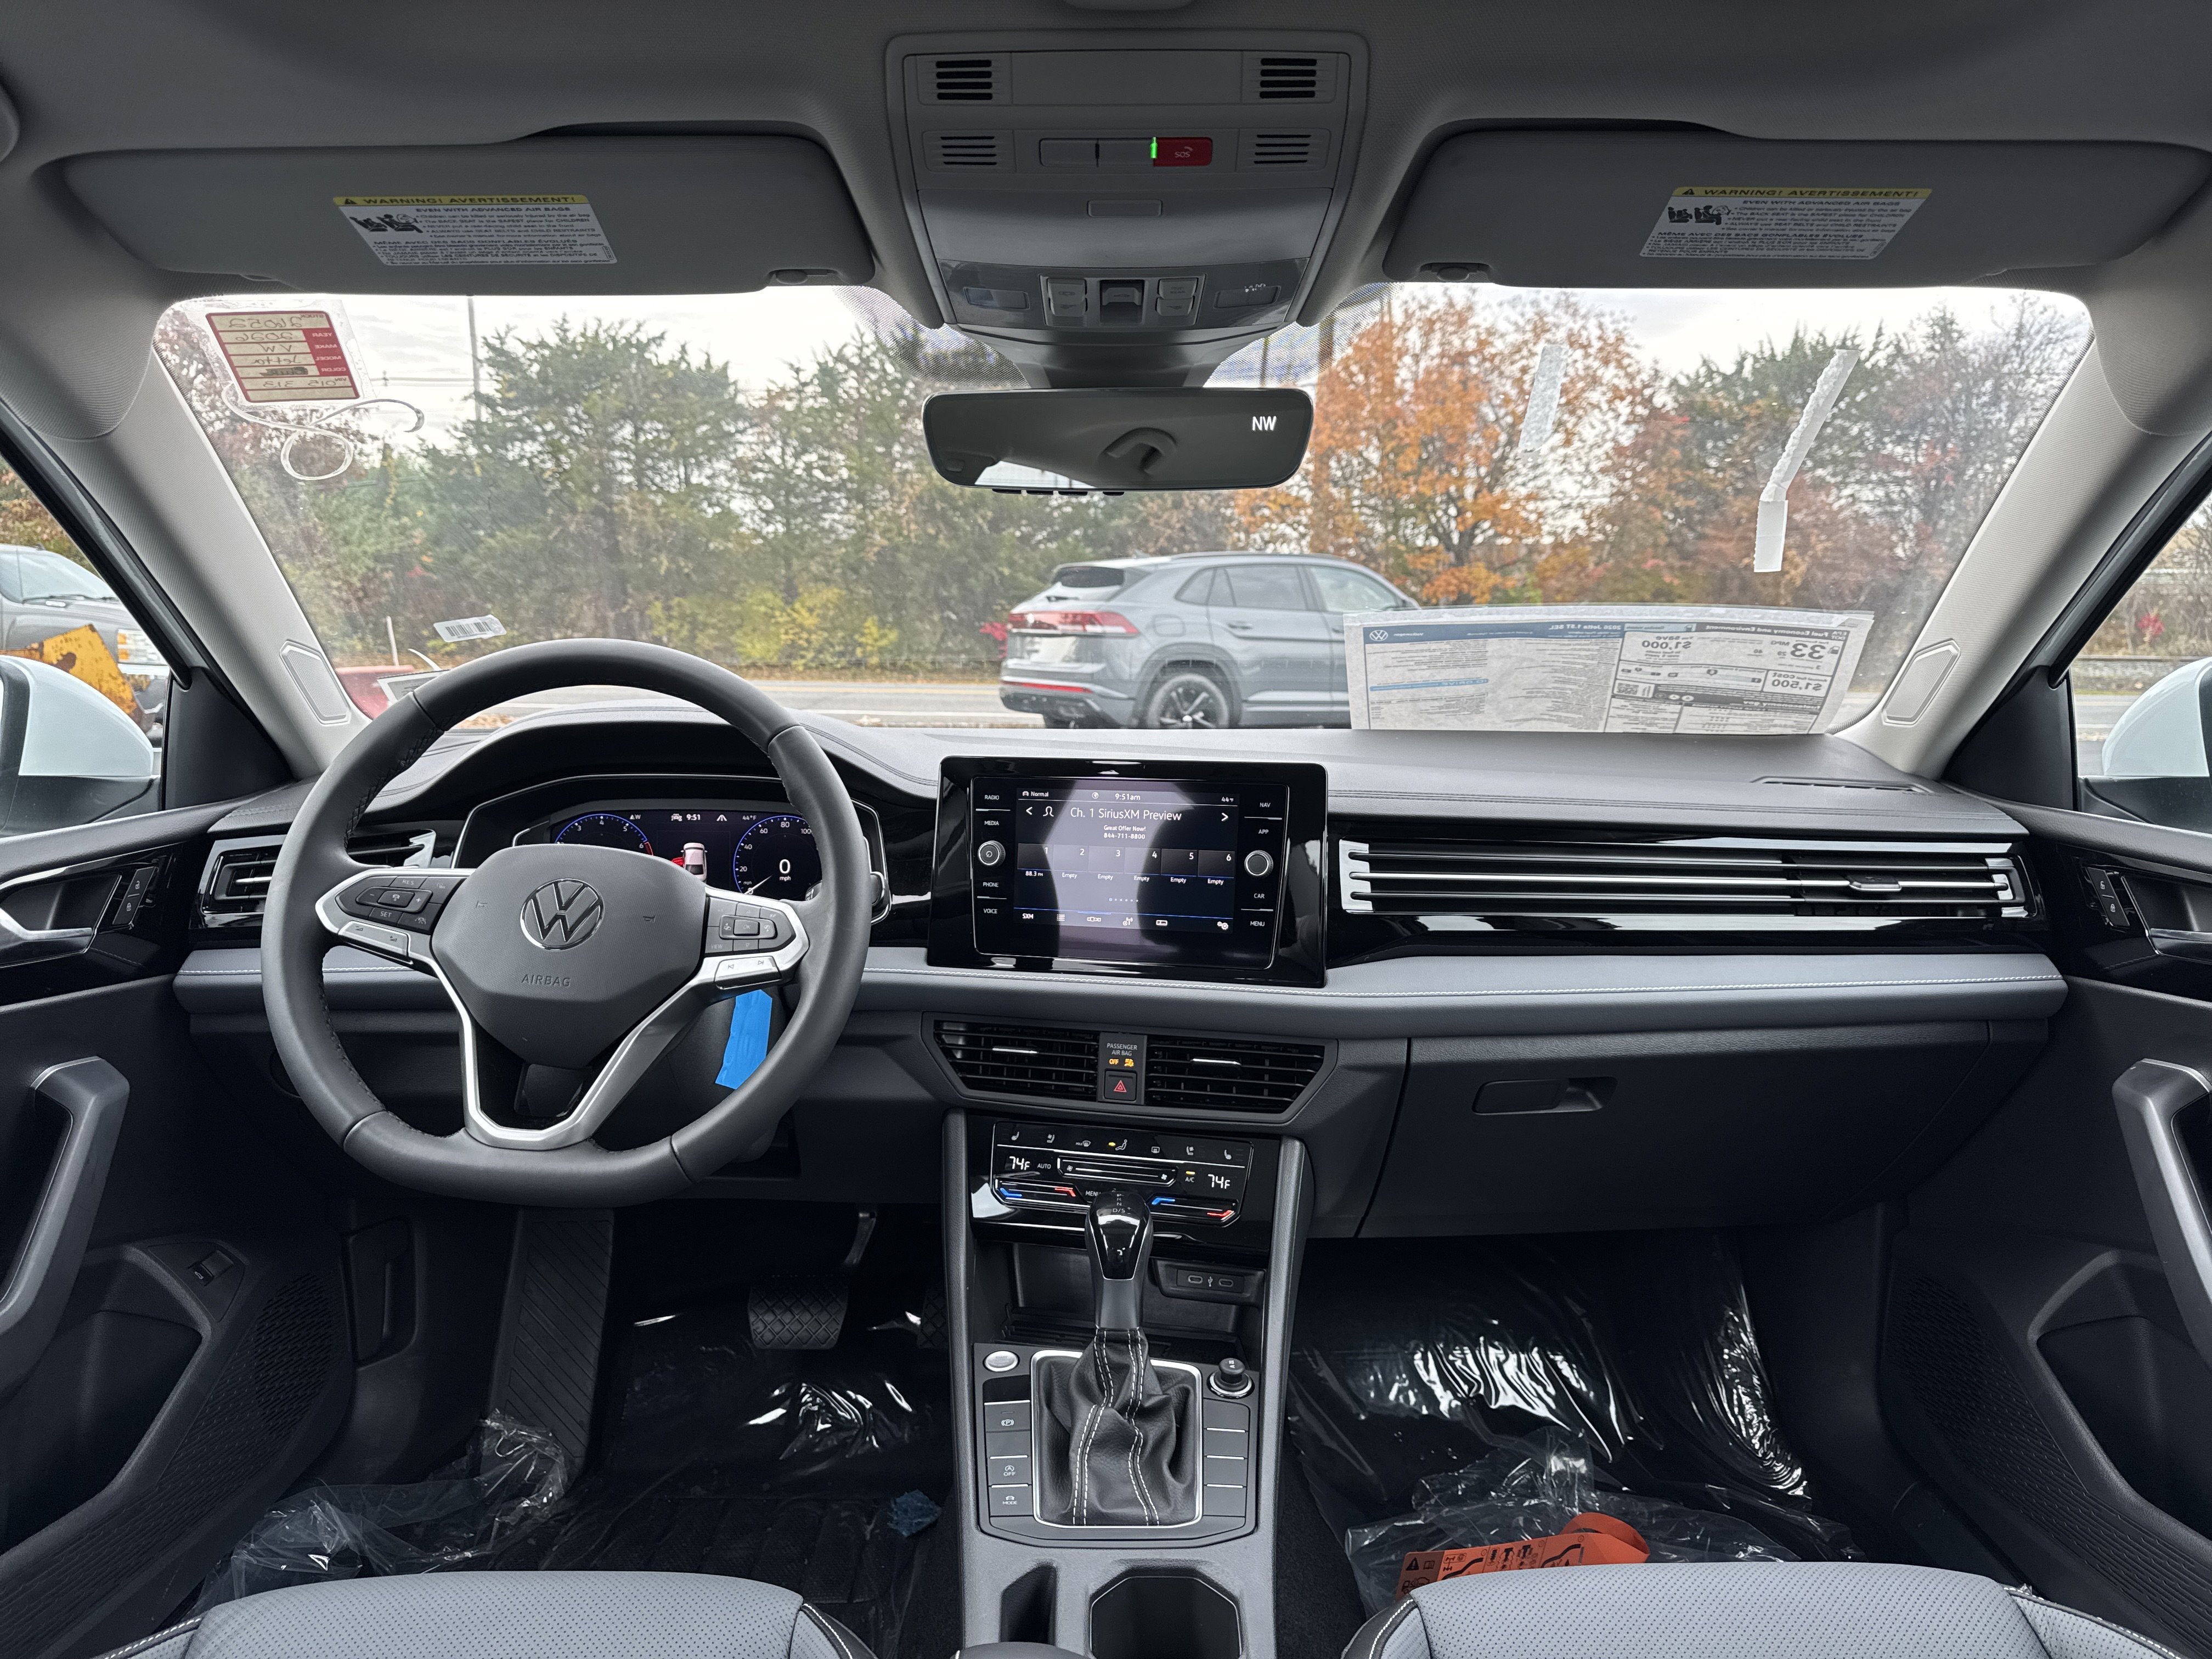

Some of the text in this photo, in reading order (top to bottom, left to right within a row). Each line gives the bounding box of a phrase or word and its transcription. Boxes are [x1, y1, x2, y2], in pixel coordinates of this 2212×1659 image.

[1252, 415, 1277, 432] NW
[1070, 807, 1182, 821] Ch. 1 SiriusXM Preview
[779, 859, 791, 874] 0
[521, 974, 572, 988] AIRBAG
